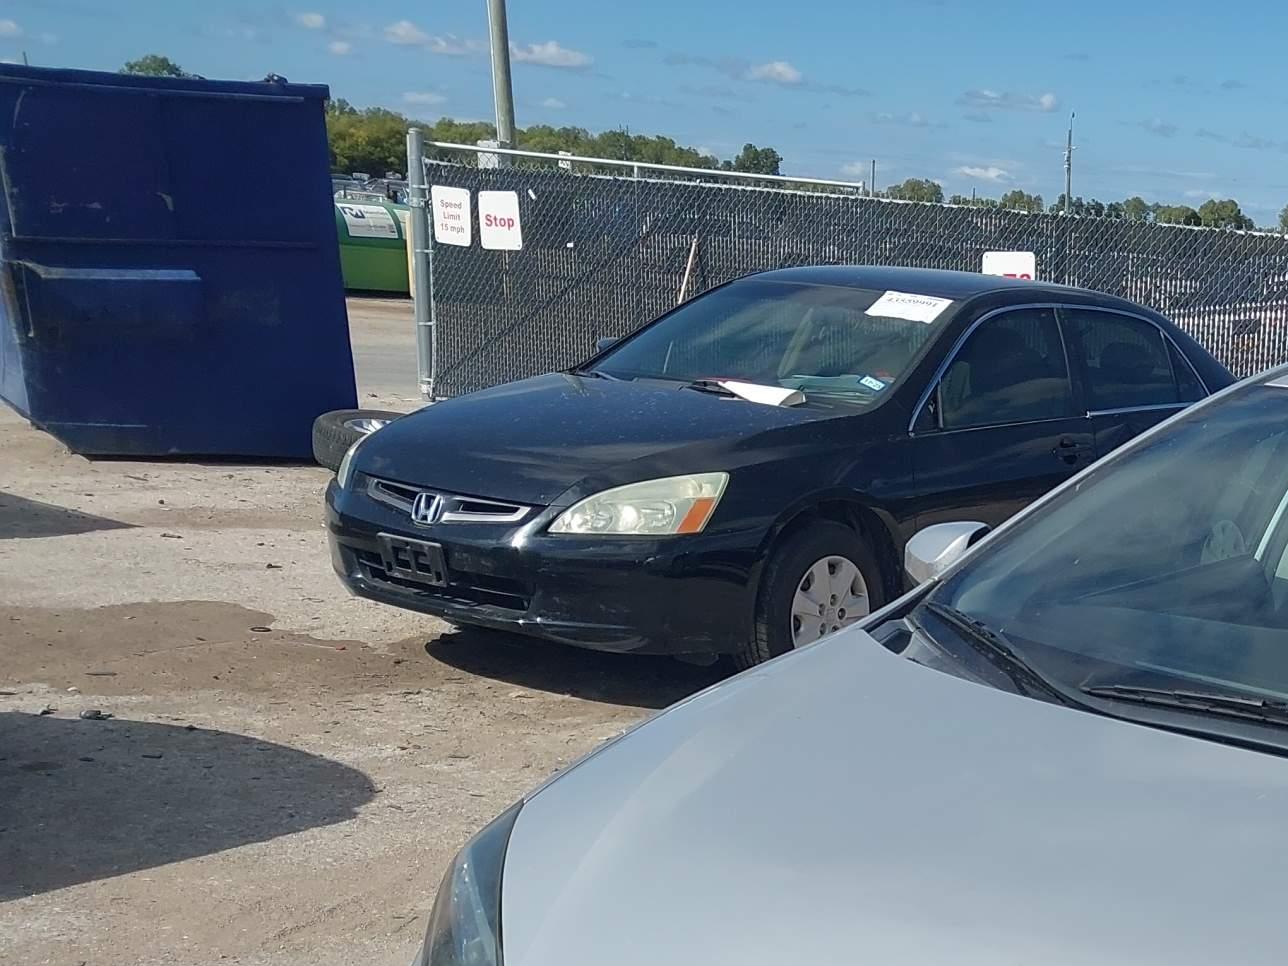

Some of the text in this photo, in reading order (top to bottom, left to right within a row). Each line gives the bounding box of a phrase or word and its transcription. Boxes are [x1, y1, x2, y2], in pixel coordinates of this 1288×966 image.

[440, 200, 462, 209] Speed
[443, 211, 461, 221] Limit
[485, 213, 515, 231] Stop
[440, 223, 465, 234] 15 mph
